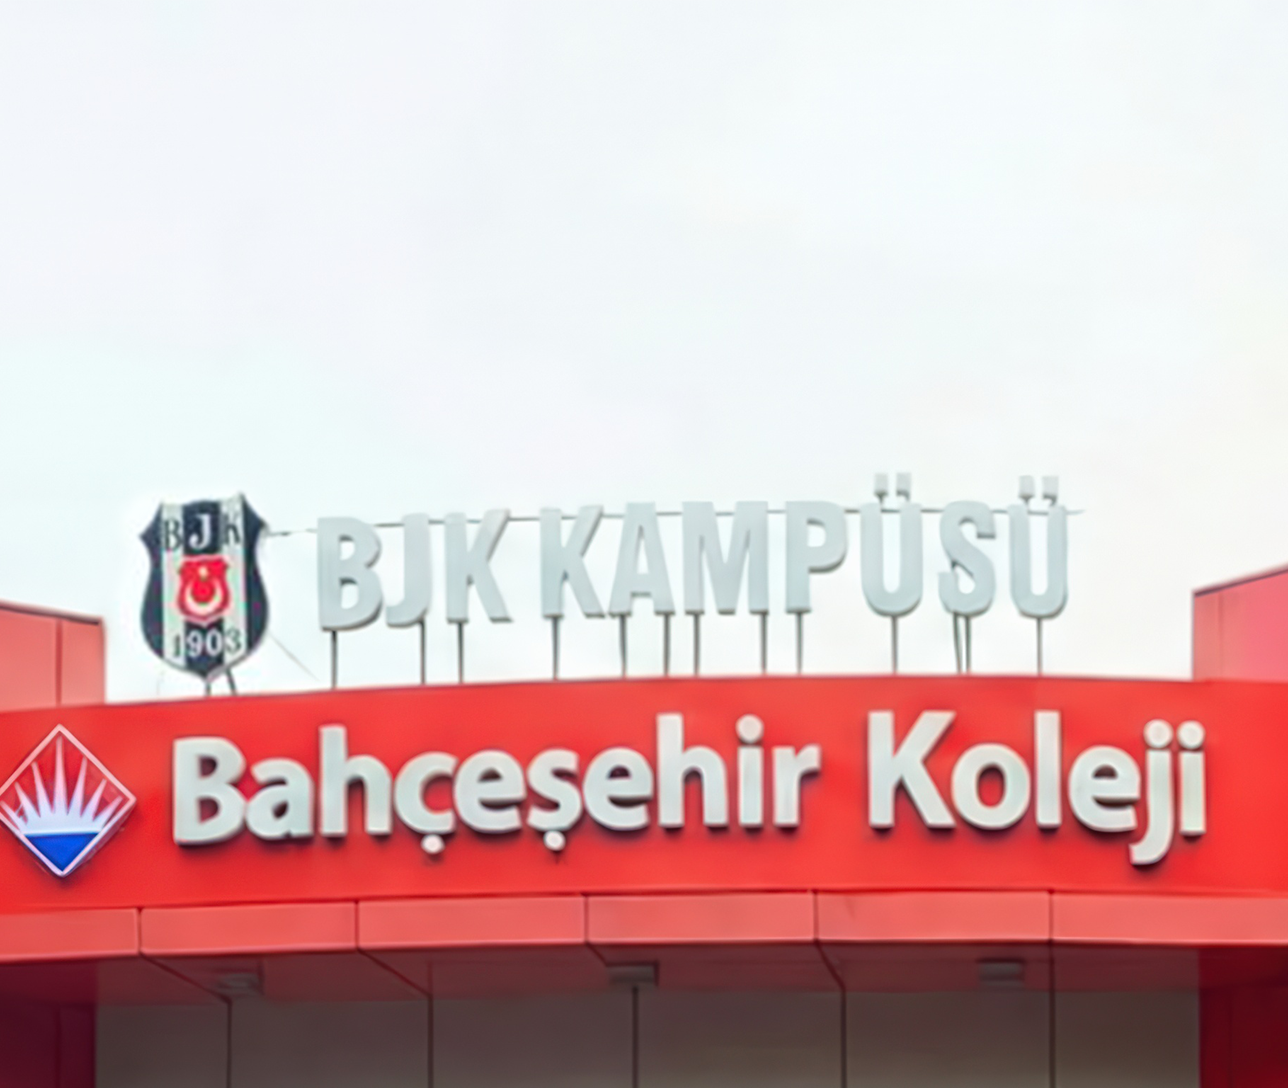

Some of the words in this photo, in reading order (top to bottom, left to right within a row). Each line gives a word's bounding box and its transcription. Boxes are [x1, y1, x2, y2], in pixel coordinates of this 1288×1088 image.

[163, 513, 241, 551] BJK
[317, 508, 513, 632] BJK
[539, 472, 1069, 620] KAMPÜSÜ
[173, 627, 242, 658] 1903
[172, 711, 821, 855] Bahçeşehir
[867, 709, 1207, 866] Koleji
